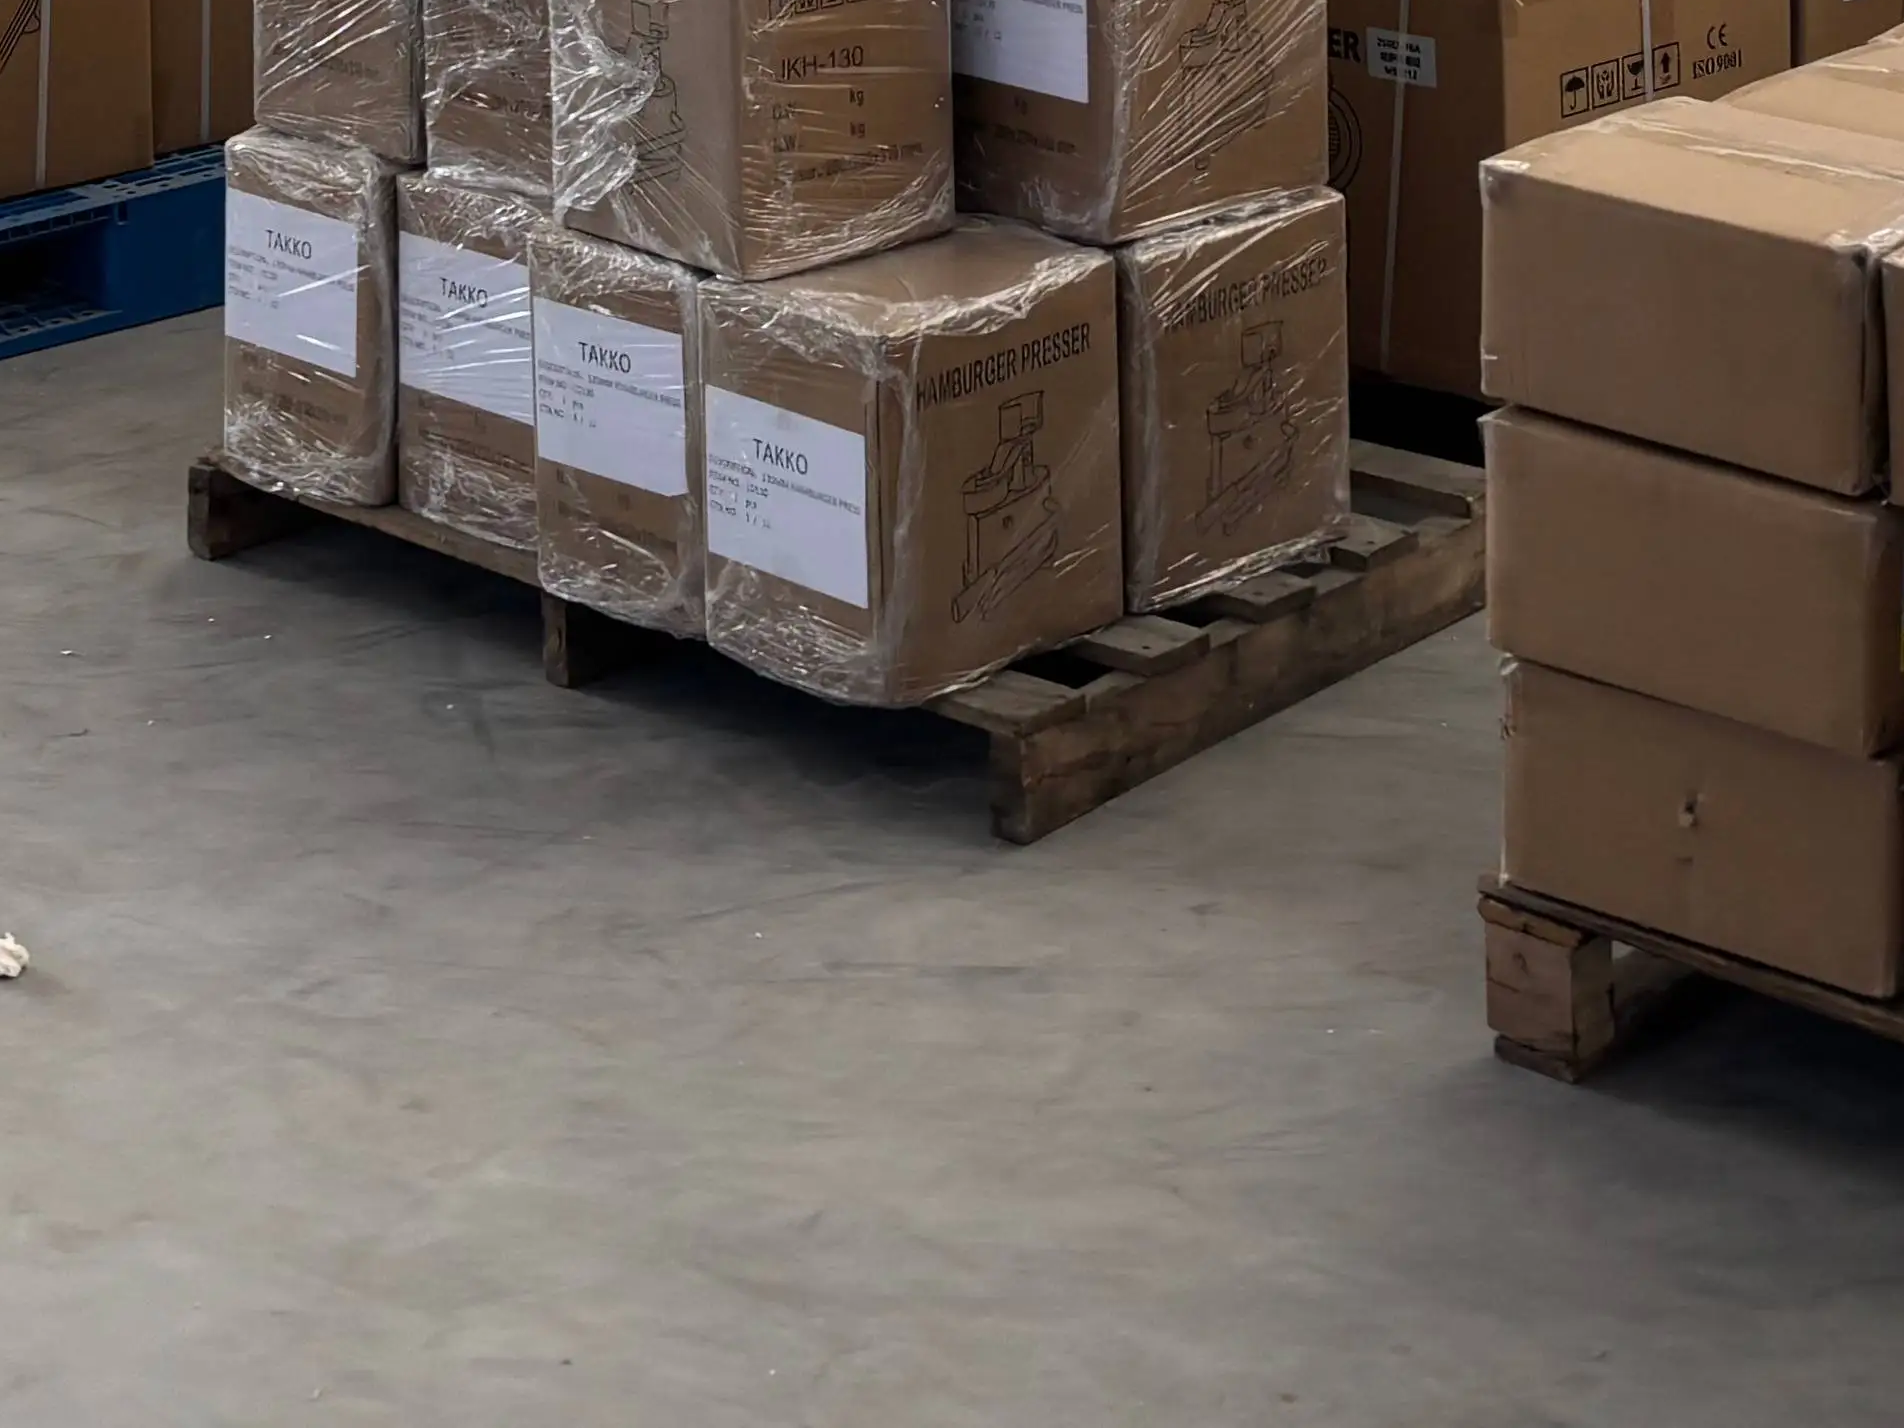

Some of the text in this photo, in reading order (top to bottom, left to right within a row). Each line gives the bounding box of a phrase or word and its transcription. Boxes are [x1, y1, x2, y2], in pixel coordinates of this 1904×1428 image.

[849, 89, 864, 106] kg
[850, 122, 866, 137] kg
[266, 229, 312, 259] TAKKO
[440, 276, 488, 308] TAKKO
[578, 341, 632, 374] TAKKO
[916, 323, 1091, 413] HAMBURGER PRESSER
[753, 438, 808, 476] TAKKO
